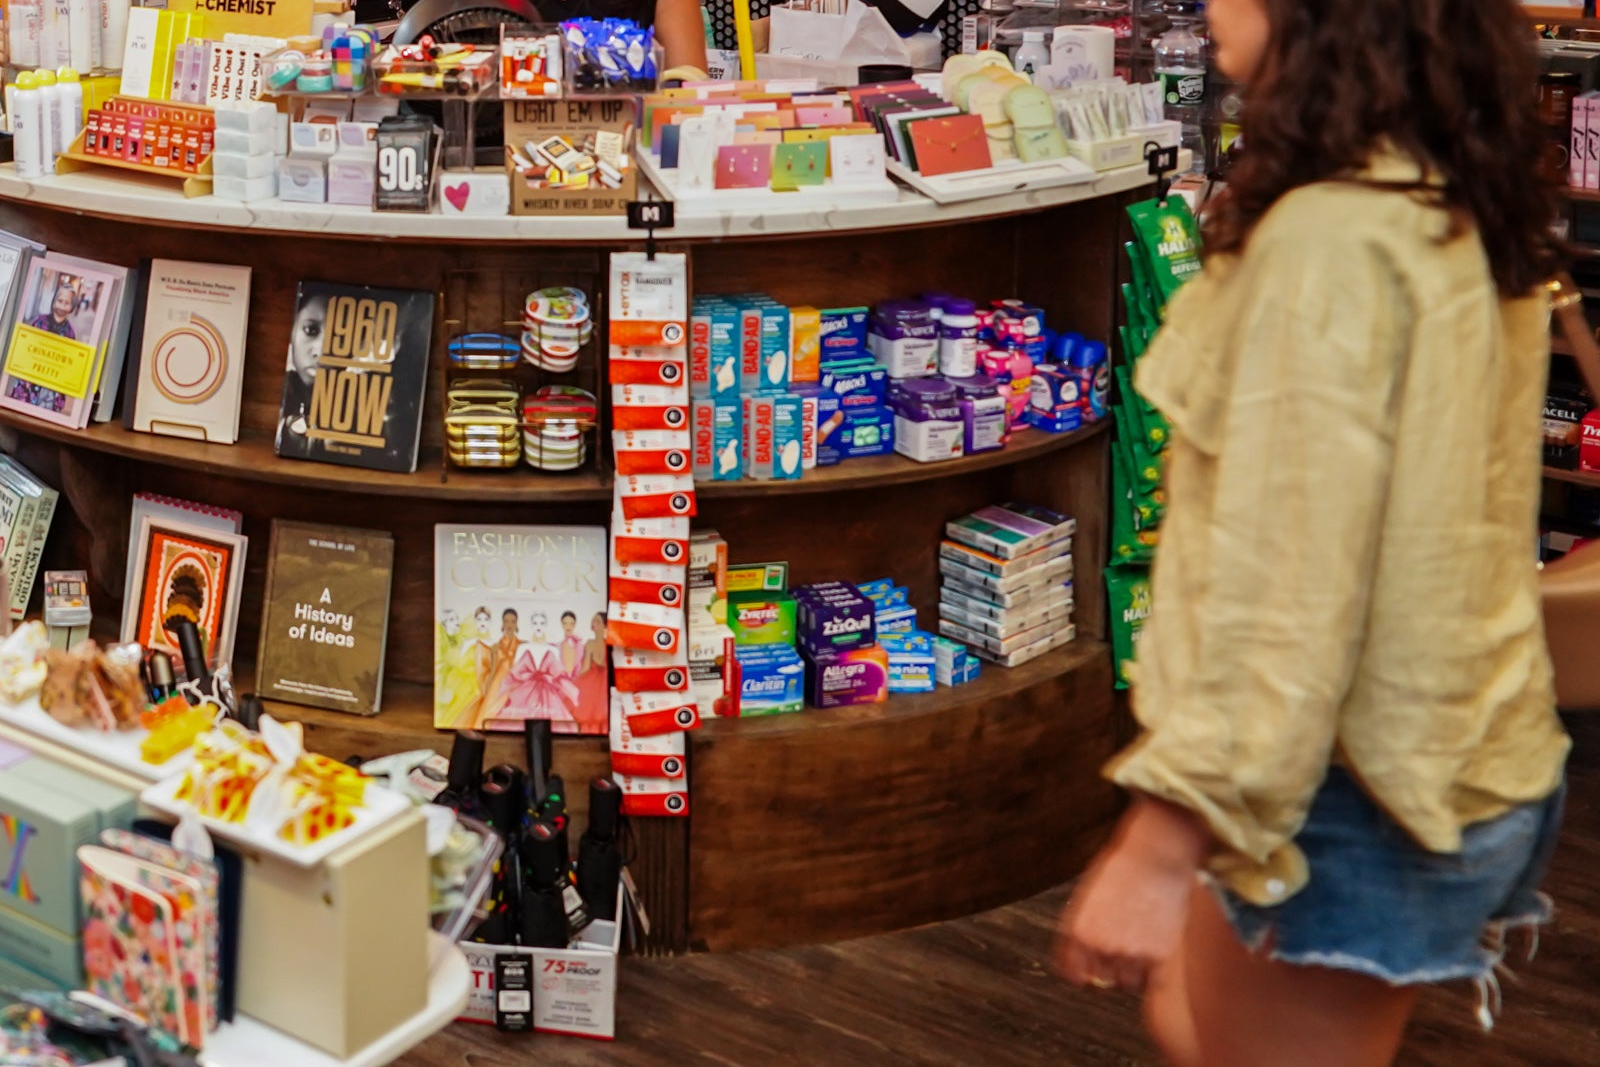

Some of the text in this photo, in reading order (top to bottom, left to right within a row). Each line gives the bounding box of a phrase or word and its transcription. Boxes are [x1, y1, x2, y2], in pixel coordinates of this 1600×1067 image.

[513, 100, 557, 123] LIGHT
[601, 100, 623, 123] UP
[523, 198, 559, 210] WHISKEY
[563, 198, 589, 210] RIVER
[592, 198, 615, 210] SOAP
[322, 296, 398, 361] 1960
[27, 344, 74, 366] CHINATOWN
[32, 363, 61, 378] PRETTY
[308, 367, 394, 437] NOW
[1542, 408, 1578, 421] ACELL
[453, 532, 597, 558] FASHION IN
[19, 546, 40, 603] ORIGAMI
[451, 556, 600, 594] COLOR
[319, 587, 332, 605] A
[294, 603, 353, 632] History
[289, 623, 355, 648] of Ideas
[823, 663, 866, 677] Allegra
[742, 678, 785, 692] Claritin
[543, 959, 567, 974] 75
[567, 966, 602, 976] PROOF
